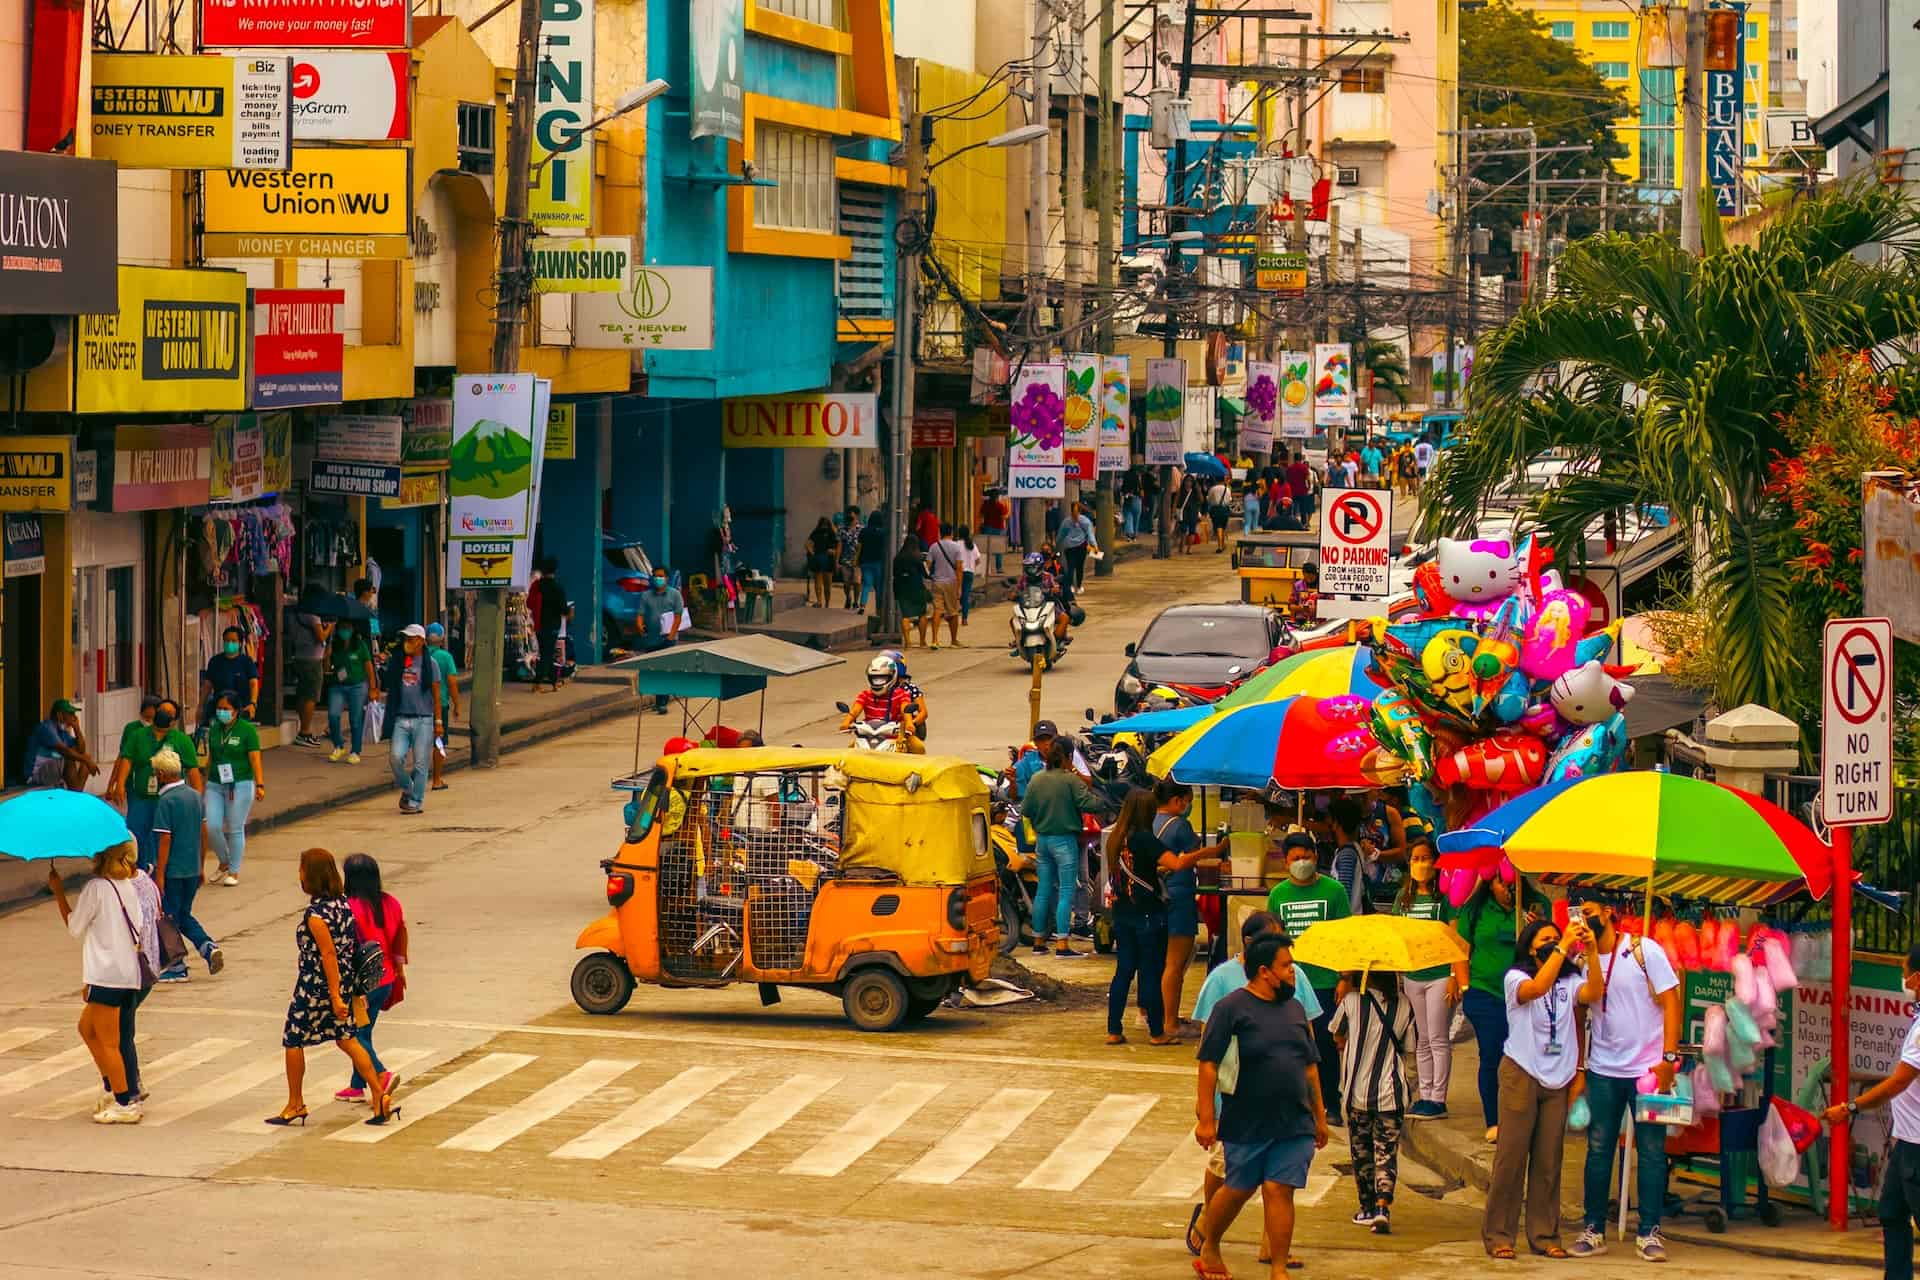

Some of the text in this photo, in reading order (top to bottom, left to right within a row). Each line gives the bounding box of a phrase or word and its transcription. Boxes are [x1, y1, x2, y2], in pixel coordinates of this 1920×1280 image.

[238, 17, 375, 33] We move your money fast!
[248, 60, 275, 73] eBiz
[94, 88, 160, 101] ESTERN
[168, 90, 215, 113] WU
[103, 101, 159, 113] UNION
[244, 102, 278, 111] money
[288, 101, 348, 116] eyGram
[240, 111, 282, 119] changer
[94, 123, 215, 137] ONEY TRANSFER
[252, 122, 270, 130] bills
[242, 131, 281, 139] payment
[1713, 73, 1736, 208] BUANA
[243, 147, 280, 157] loading
[245, 156, 278, 164] center
[227, 169, 334, 188] Western
[263, 191, 389, 214] Union WU
[238, 239, 376, 255] MONEY CHANGER
[1258, 257, 1304, 268] CHOICE
[85, 313, 120, 336] MONEY
[146, 309, 199, 338] WESTERN
[600, 324, 623, 332] TEA
[205, 310, 235, 371] WU
[84, 341, 136, 370] TRANSFER
[162, 341, 199, 370] UNION
[14, 455, 56, 475] WU
[314, 475, 338, 489] GOLD
[339, 476, 371, 493] REPAIR
[372, 479, 397, 494] SHOP
[1016, 476, 1057, 489] NCCC
[0, 485, 56, 496] RANSFER
[465, 543, 511, 553] BOYSEN
[1322, 546, 1388, 567] NO PARKING
[1328, 566, 1377, 575] FROM HERE TO
[1340, 574, 1352, 582] SAN
[1353, 575, 1373, 583] PEDRO
[1333, 582, 1371, 592] CTTMO
[1847, 733, 1869, 754] NO
[1835, 761, 1880, 785] RIGHT
[1836, 790, 1878, 814] TURN
[1695, 985, 1724, 998] DAPAT
[1799, 1009, 1817, 1026] Do
[1850, 1020, 1885, 1036] eave
[1876, 1060, 1891, 1073] or
